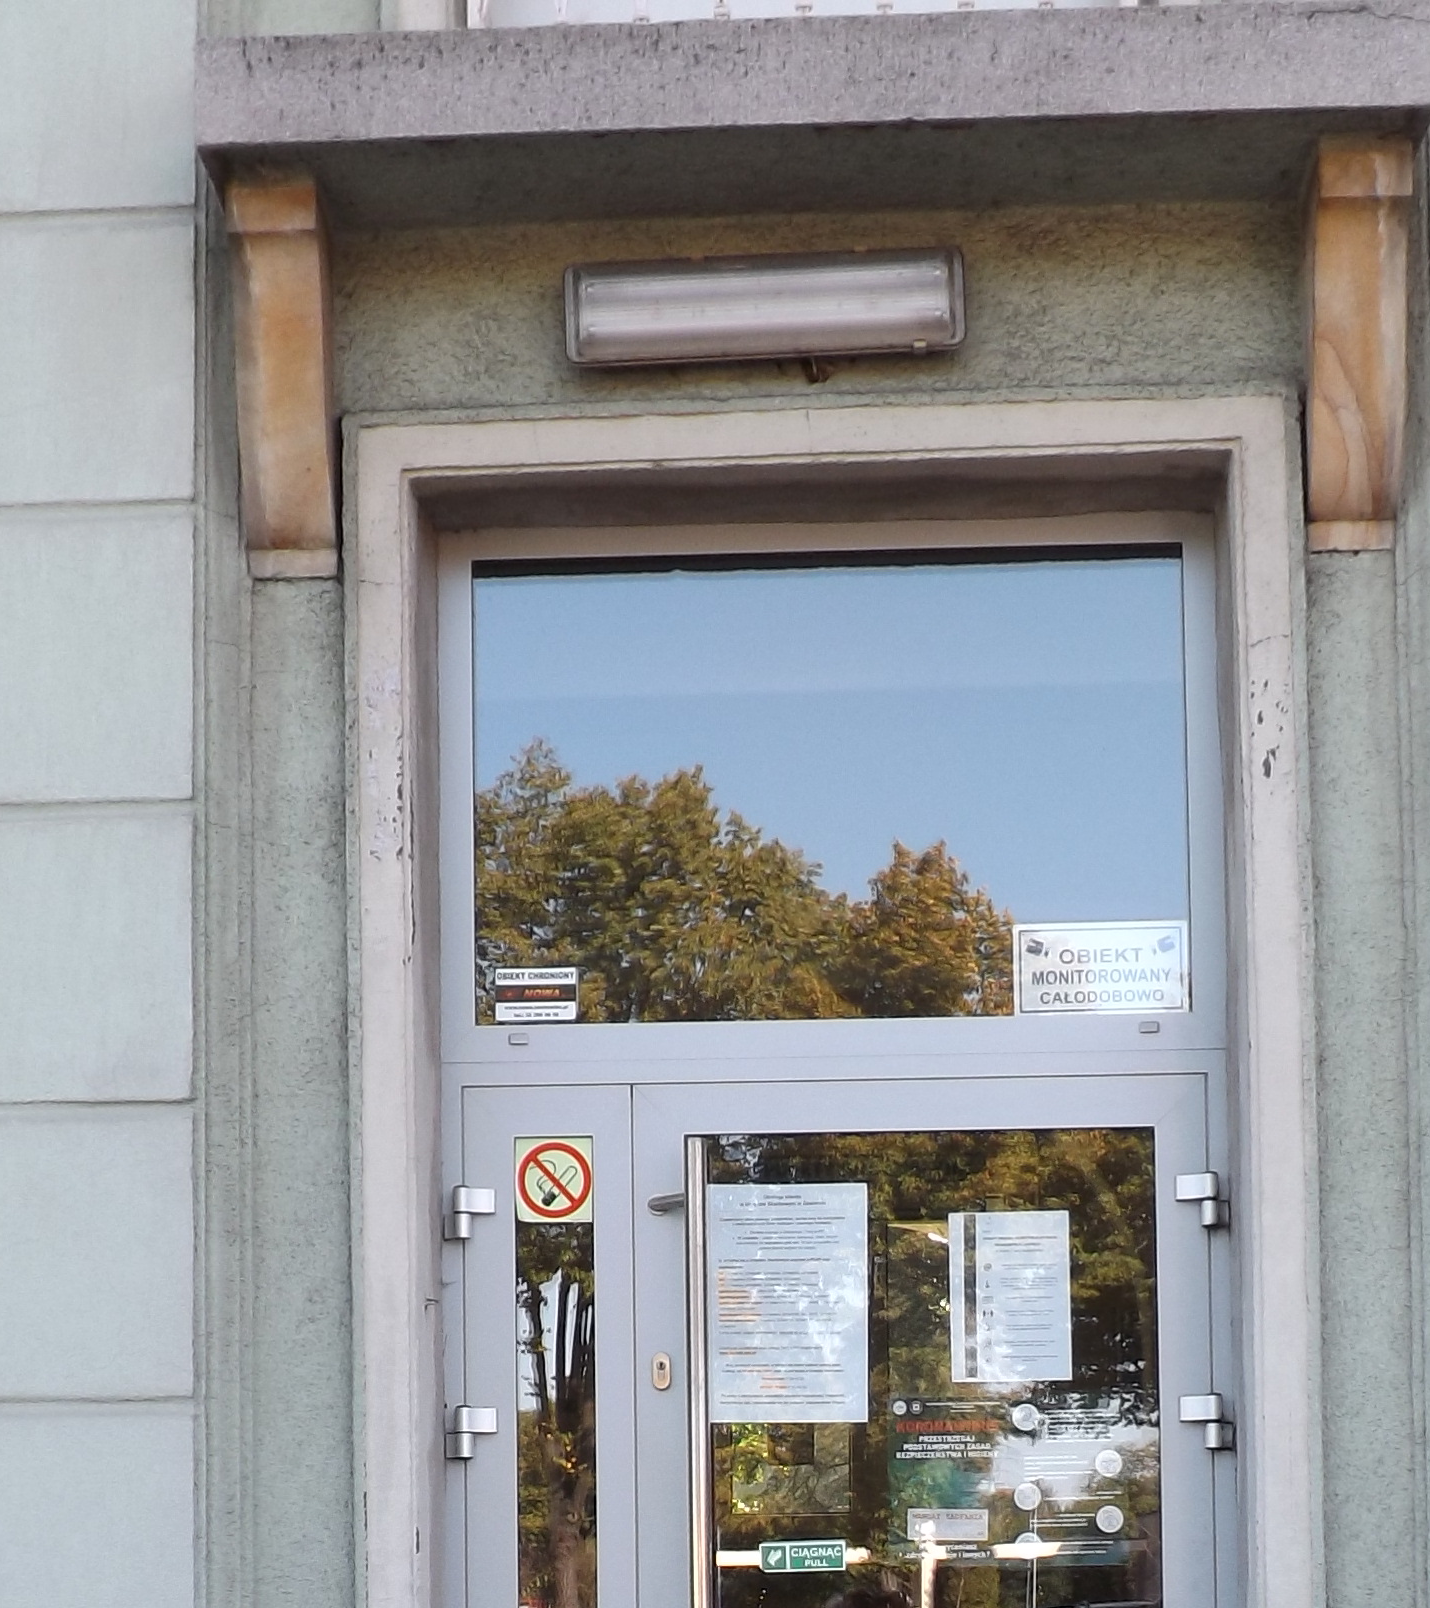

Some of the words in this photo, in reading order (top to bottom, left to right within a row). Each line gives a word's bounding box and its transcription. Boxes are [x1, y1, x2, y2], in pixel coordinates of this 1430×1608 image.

[1059, 948, 1143, 964] OBIEKT
[497, 972, 526, 980] OBIEKT
[528, 971, 574, 980] CHRONIONY
[1032, 968, 1171, 985] MONITOROWANY
[523, 989, 560, 997] NOWA
[1040, 989, 1164, 1004] CAŁODOBOWO
[791, 1546, 842, 1559] CIĄGNĄĆ
[804, 1559, 829, 1567] PULL
